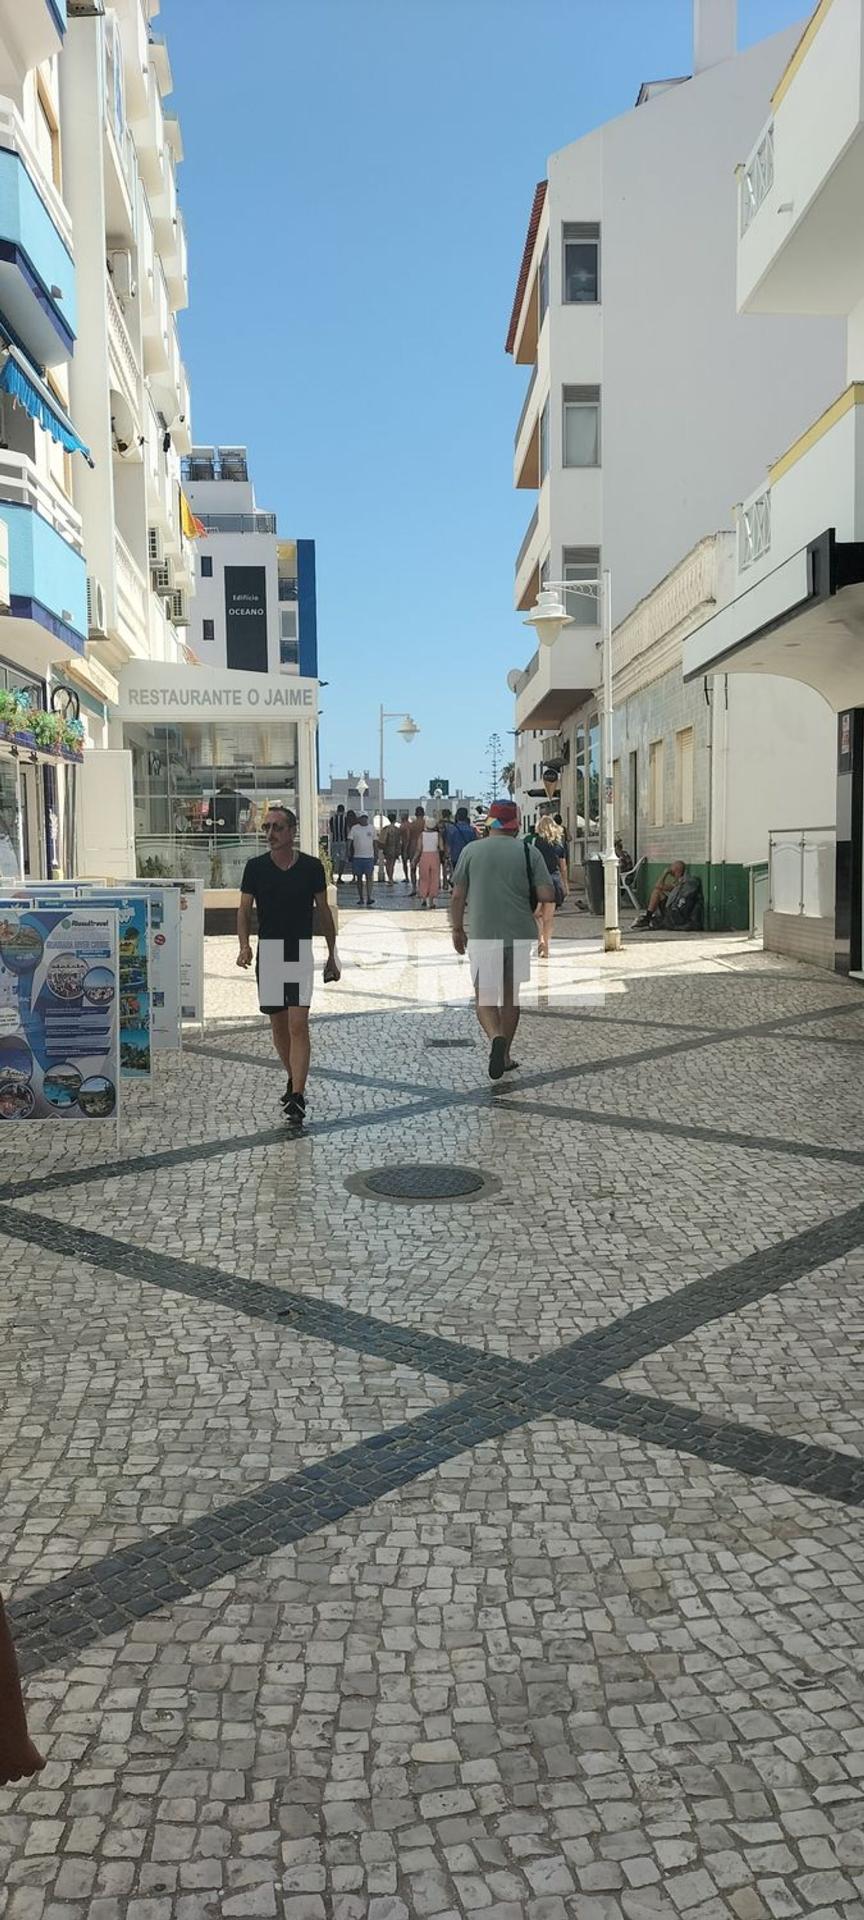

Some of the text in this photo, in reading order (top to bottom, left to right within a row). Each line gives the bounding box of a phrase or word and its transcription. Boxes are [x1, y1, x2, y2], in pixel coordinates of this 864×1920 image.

[228, 608, 264, 616] OCEANO
[128, 688, 313, 706] RESTAURANTE O JAIME
